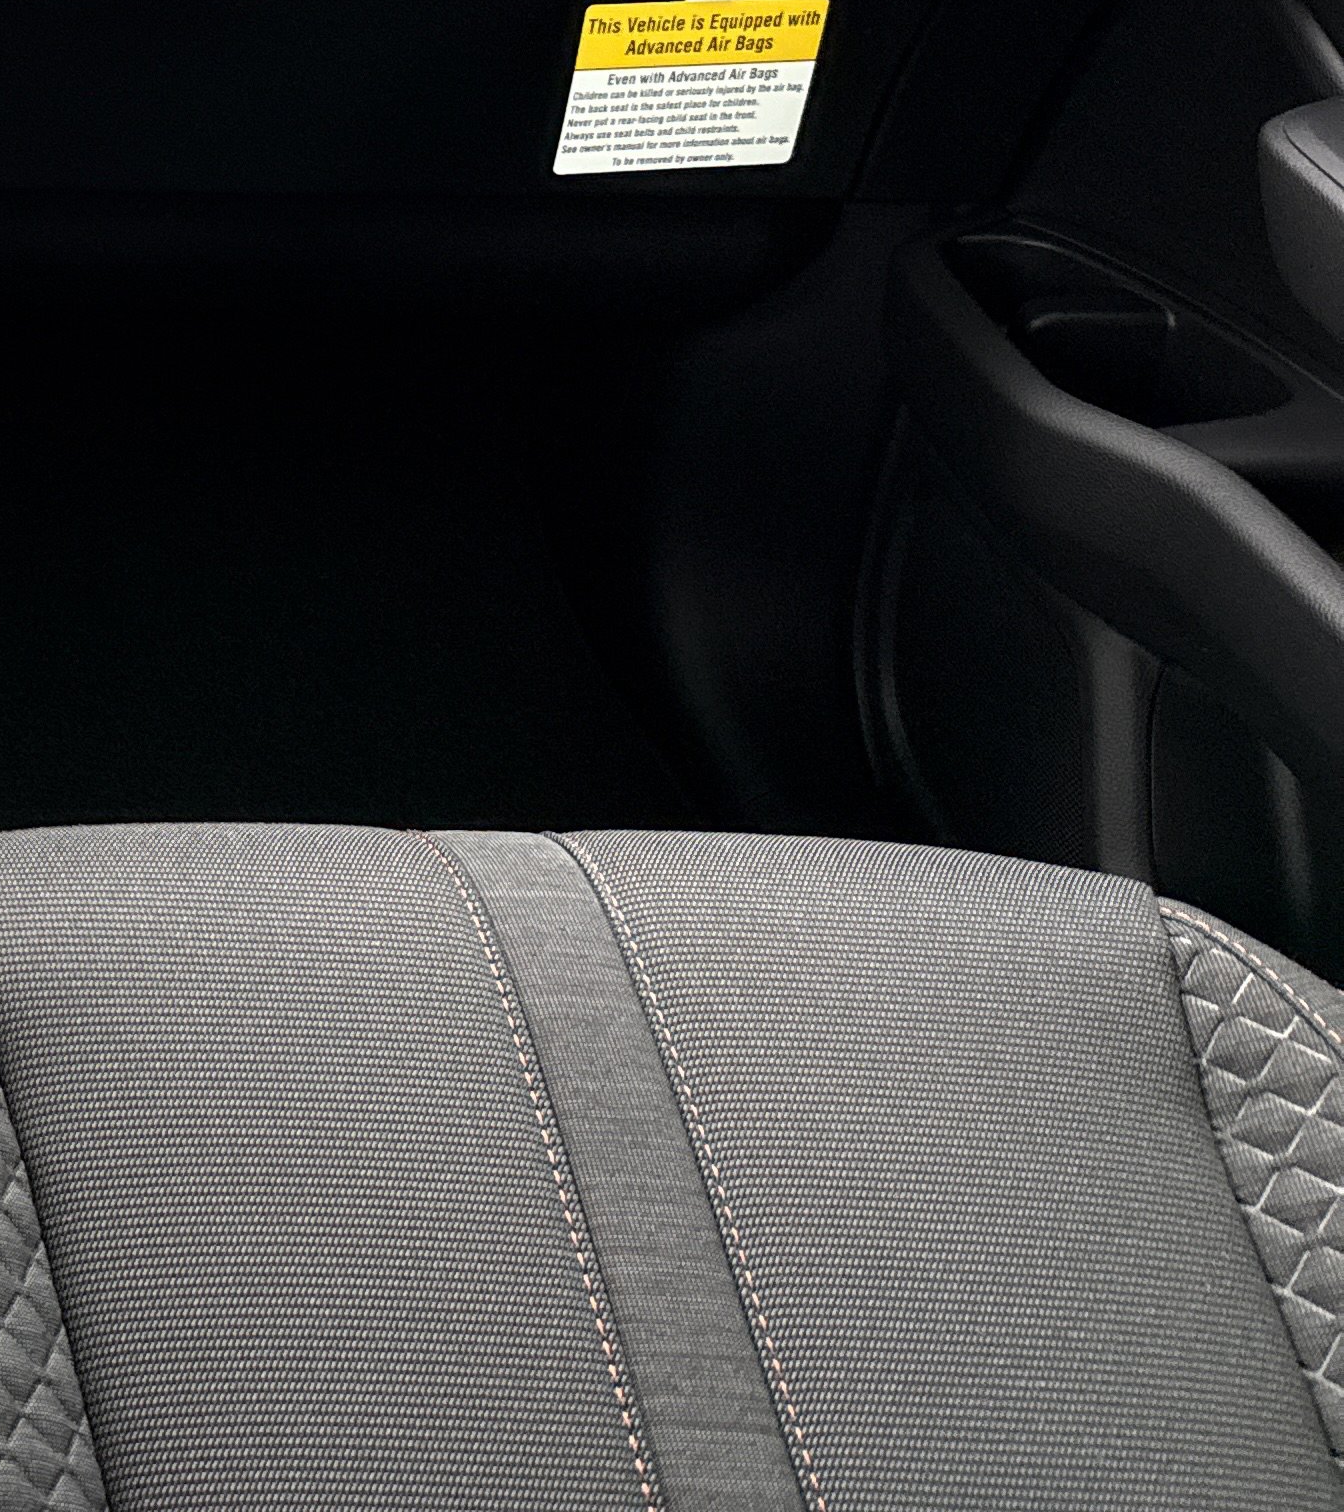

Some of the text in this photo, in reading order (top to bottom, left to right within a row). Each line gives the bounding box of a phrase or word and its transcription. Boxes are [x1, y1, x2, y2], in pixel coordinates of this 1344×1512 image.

[588, 10, 821, 35] This Vehicle is Equipped with
[625, 35, 773, 55] Advanced Air Bags
[607, 68, 779, 85] Even with Advanced Air Bags
[573, 91, 608, 100] Children
[610, 91, 625, 99] can
[627, 90, 637, 98] be
[640, 88, 663, 97] killed
[676, 87, 714, 96] seriously
[716, 85, 745, 95] injured
[748, 84, 756, 94] by
[758, 83, 771, 92] the
[773, 83, 785, 92] air
[571, 98, 759, 114] The back seat is the safest place for children.
[567, 118, 592, 127] Never
[594, 117, 609, 128] put
[618, 115, 664, 125] rear-facing
[666, 114, 687, 122] child
[689, 113, 708, 121] seat
[709, 112, 717, 121] in
[719, 112, 732, 120] the
[734, 111, 757, 119] front.
[564, 125, 739, 141] Always use seat belts and child restraints.
[561, 145, 577, 154] See
[579, 144, 612, 152] owner's
[613, 142, 644, 151] manual
[646, 141, 658, 149] for
[659, 140, 681, 148] more
[682, 138, 730, 147] information
[731, 137, 754, 145] about
[755, 136, 767, 144] air
[612, 153, 734, 166] To be removed by owner only.
